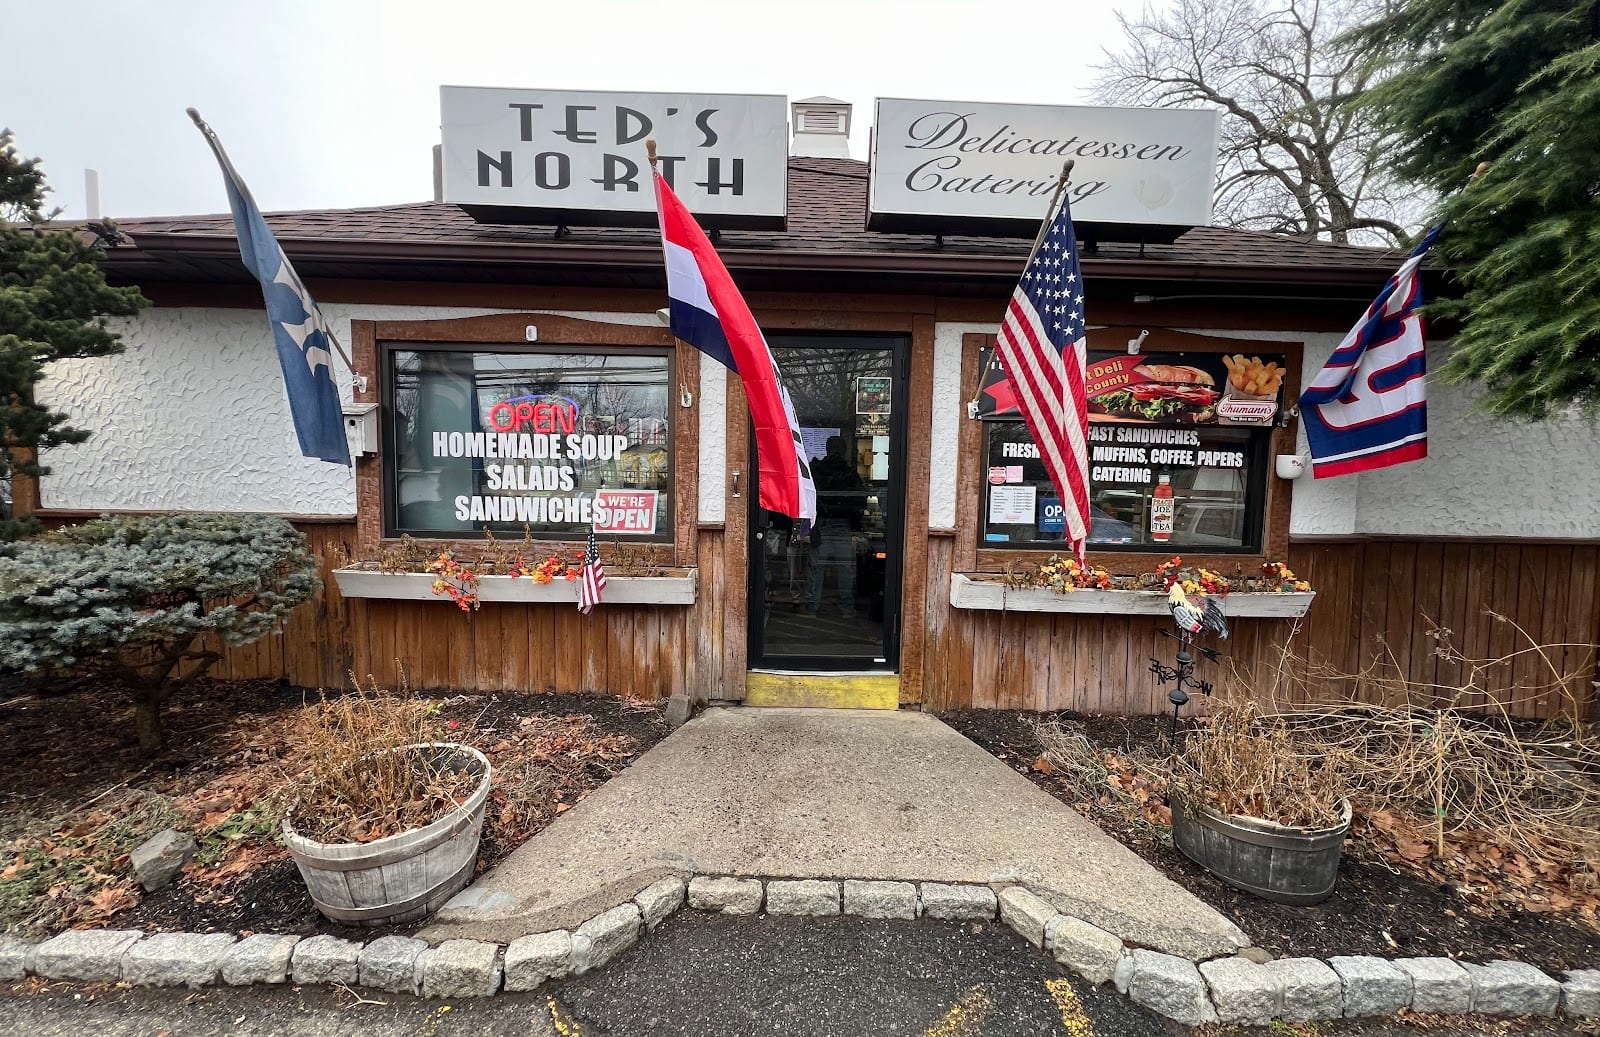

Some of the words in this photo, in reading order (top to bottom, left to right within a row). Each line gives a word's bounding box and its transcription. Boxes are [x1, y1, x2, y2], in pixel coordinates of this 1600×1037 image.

[509, 103, 720, 147] TED'S
[905, 111, 1191, 162] Delicatessen
[477, 149, 744, 196] NORTH
[905, 155, 1112, 205] Catering
[1093, 361, 1123, 378] Deli
[1086, 374, 1129, 394] County
[489, 402, 576, 433] OPEN
[1220, 402, 1272, 415] Thumann's
[433, 432, 560, 459] HOMEMADE
[566, 434, 628, 460] SOUP
[1116, 426, 1200, 446] SANDWICHES,
[1092, 446, 1148, 464] MUFFINS,
[1150, 448, 1195, 466] COFFEE,
[1197, 451, 1244, 467] PAPERS
[487, 464, 574, 491] SALADS
[1092, 467, 1151, 483] CATERING
[454, 495, 607, 523] SANDWICHES
[608, 495, 646, 507] WE'RE
[600, 508, 651, 529] OPEN
[1153, 522, 1170, 530] TEA
